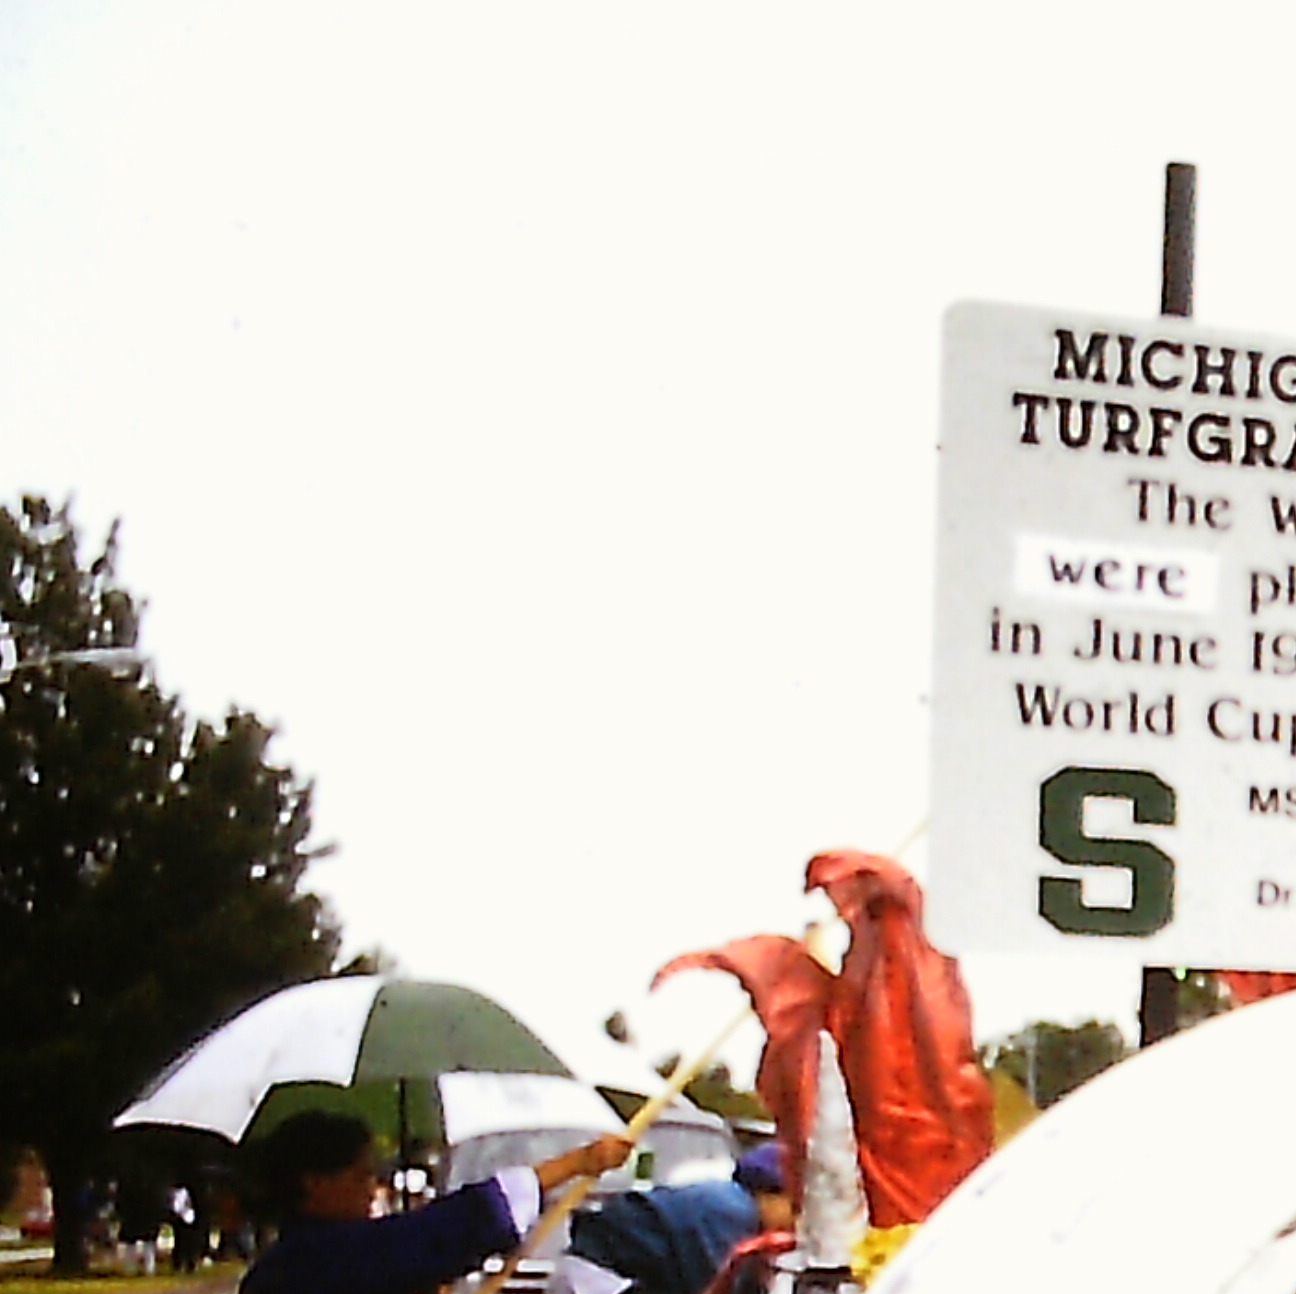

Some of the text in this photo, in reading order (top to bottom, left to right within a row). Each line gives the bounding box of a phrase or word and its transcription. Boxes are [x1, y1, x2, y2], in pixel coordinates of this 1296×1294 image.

[1127, 479, 1233, 530] The
[1048, 553, 1187, 598] were
[990, 606, 1043, 655] in
[1073, 618, 1219, 670] June
[1015, 683, 1176, 737] World
[1038, 765, 1177, 938] S
